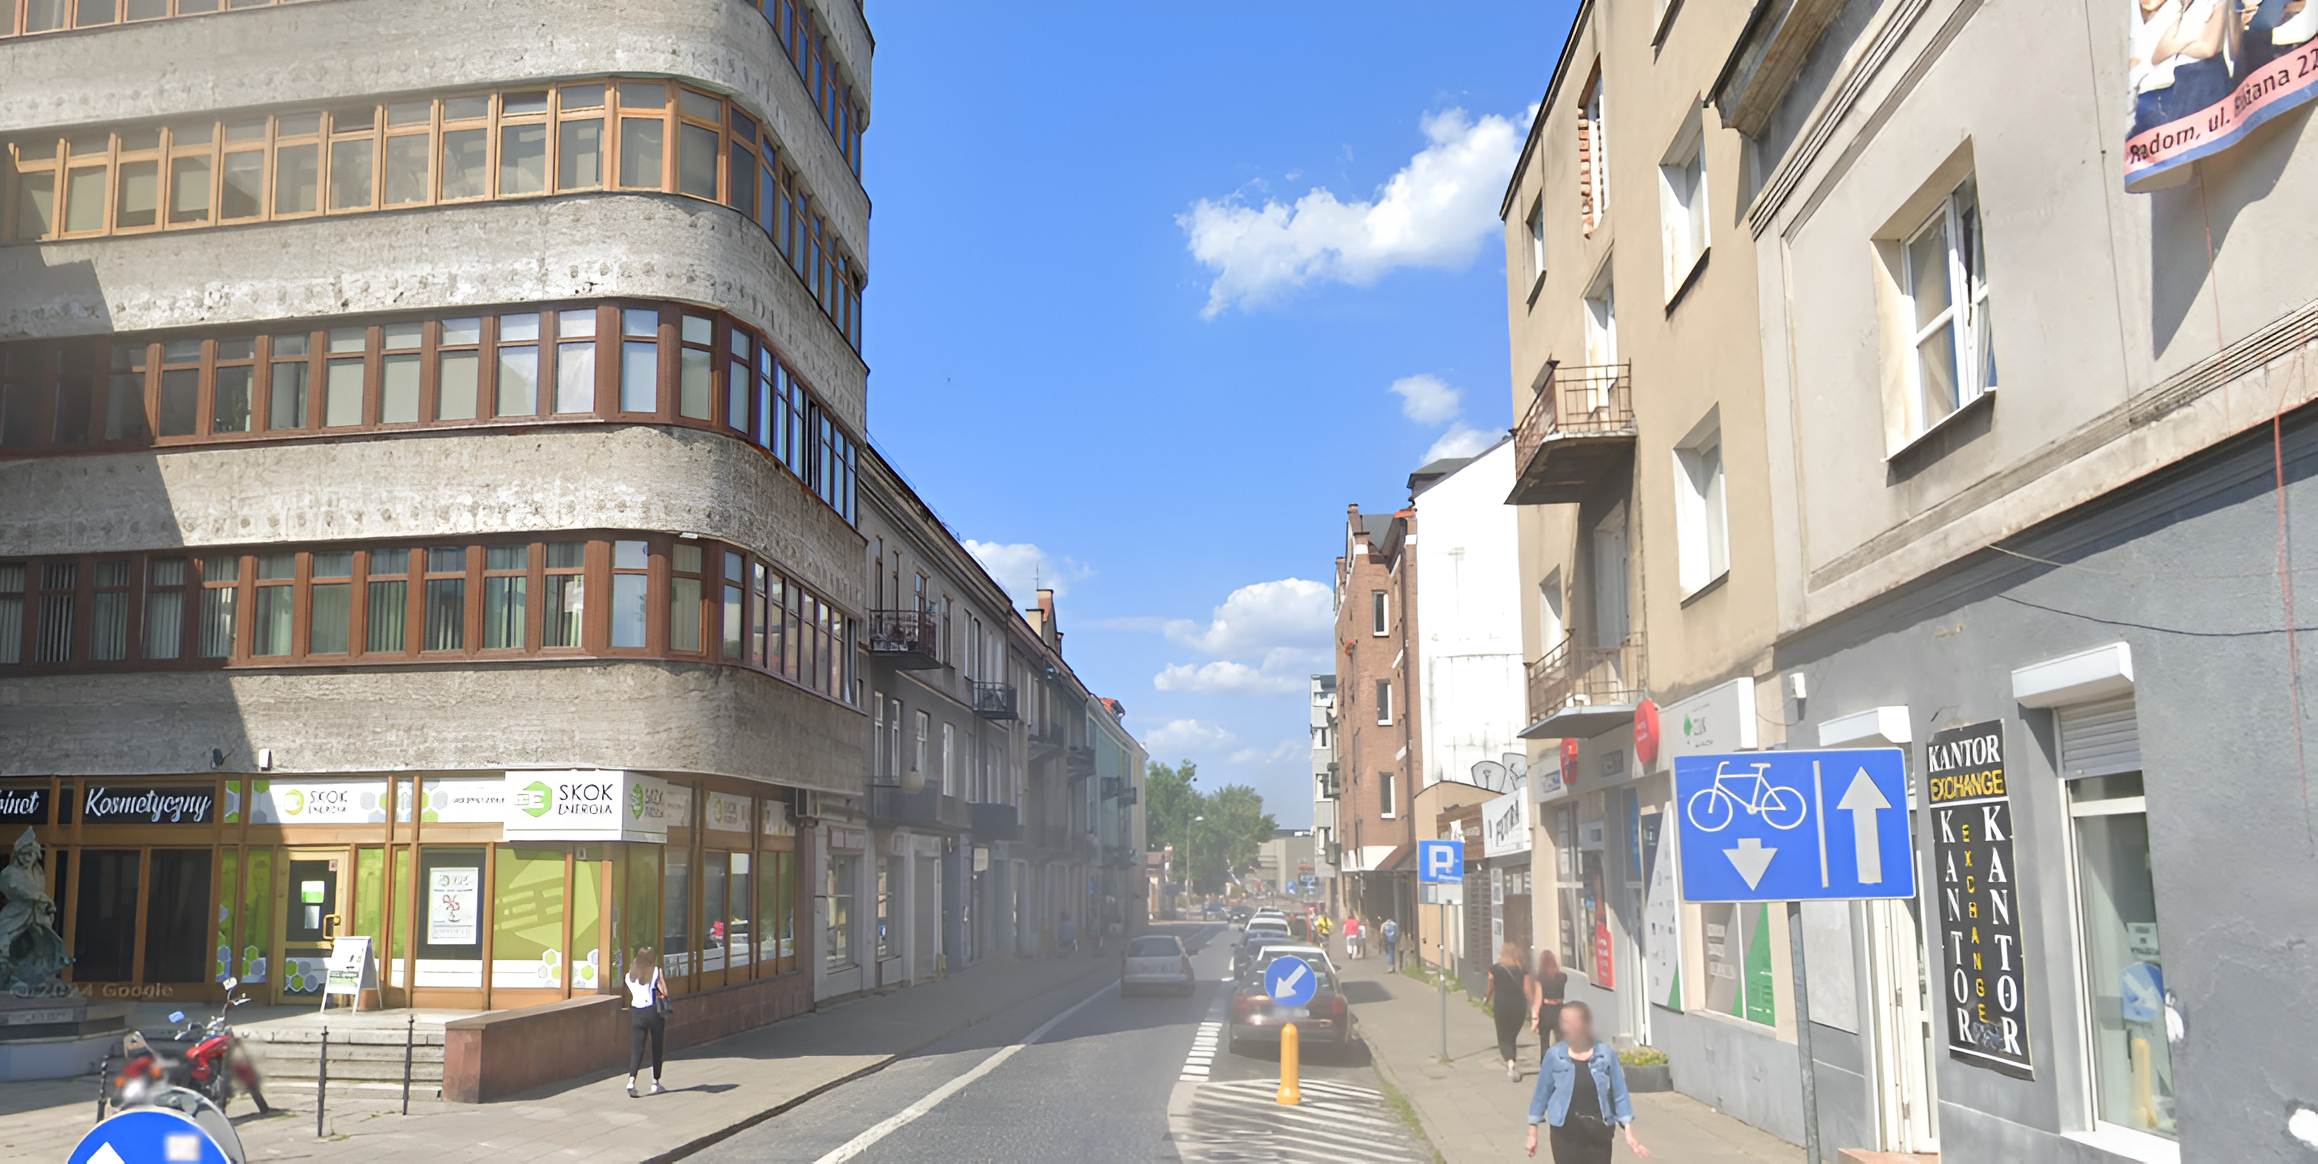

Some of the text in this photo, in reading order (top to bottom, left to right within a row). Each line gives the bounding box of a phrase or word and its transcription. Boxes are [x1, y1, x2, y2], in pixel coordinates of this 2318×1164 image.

[2208, 106, 2231, 133] ul.
[1928, 735, 2001, 772] KANTOR
[559, 784, 613, 801] SKOK
[1930, 769, 2005, 801] EXCHANGE
[85, 787, 211, 823] Kosmetyczny
[1428, 844, 1454, 878] P
[1940, 809, 1977, 1044] KANTOR
[1962, 823, 1990, 1024] EXCHANGE
[1982, 805, 2022, 1056] KANTOR
